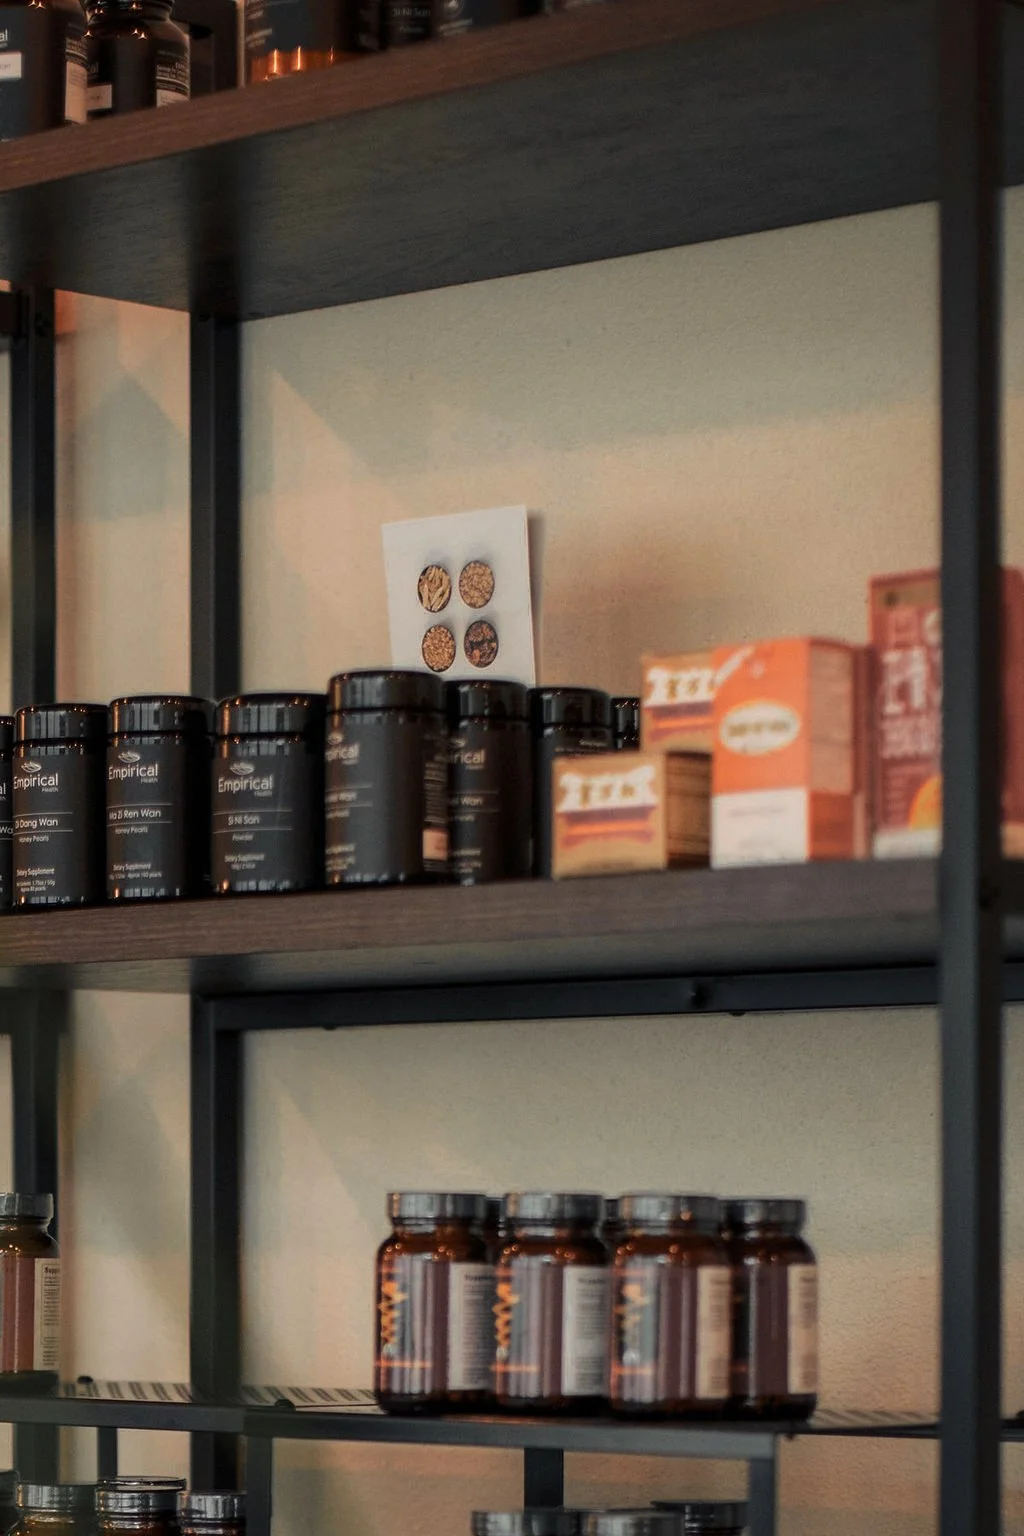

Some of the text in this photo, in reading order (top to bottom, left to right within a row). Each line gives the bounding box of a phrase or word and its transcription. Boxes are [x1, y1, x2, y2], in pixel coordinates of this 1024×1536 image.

[13, 772, 59, 790] Empirical
[108, 763, 159, 781] Empirical
[217, 774, 273, 793] Empirical
[124, 809, 139, 819] Ren
[140, 808, 162, 818] Wan
[20, 819, 38, 829] Dang
[38, 818, 59, 827] Wan
